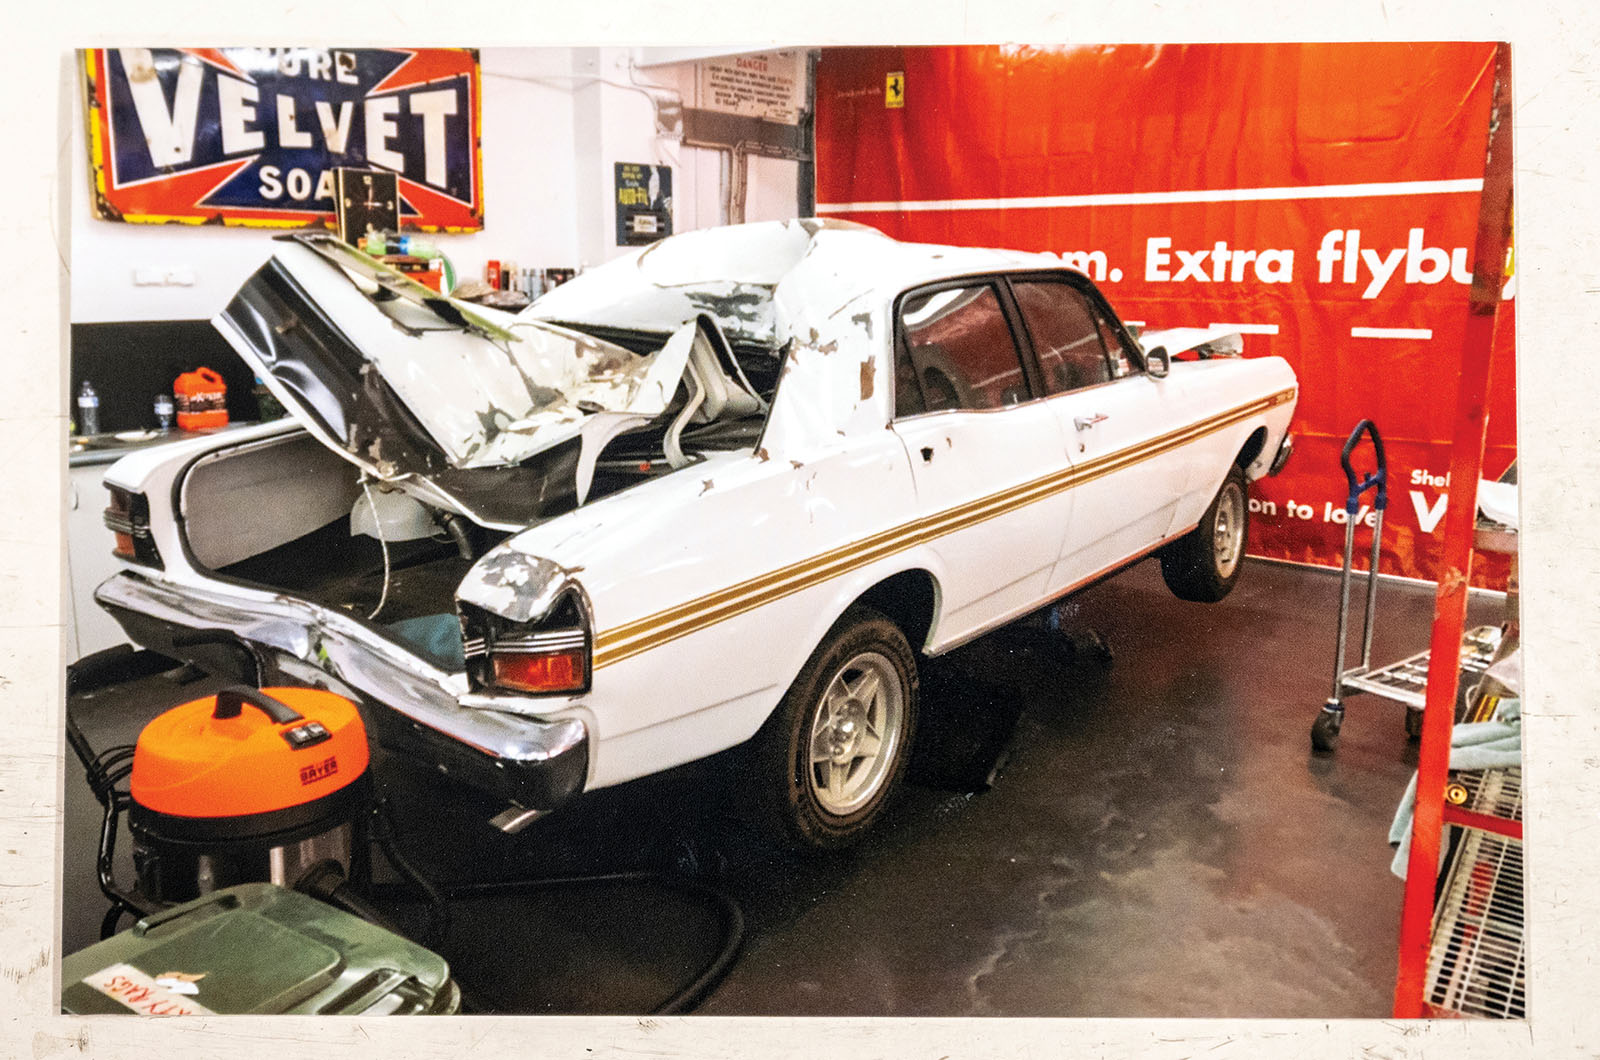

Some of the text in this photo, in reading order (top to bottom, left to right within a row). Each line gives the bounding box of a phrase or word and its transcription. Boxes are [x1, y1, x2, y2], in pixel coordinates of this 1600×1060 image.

[736, 58, 768, 71] DANGER
[118, 48, 458, 189] VELVET
[258, 166, 334, 200] SOA
[1145, 237, 1294, 283] Extra
[1286, 499, 1314, 520] to
